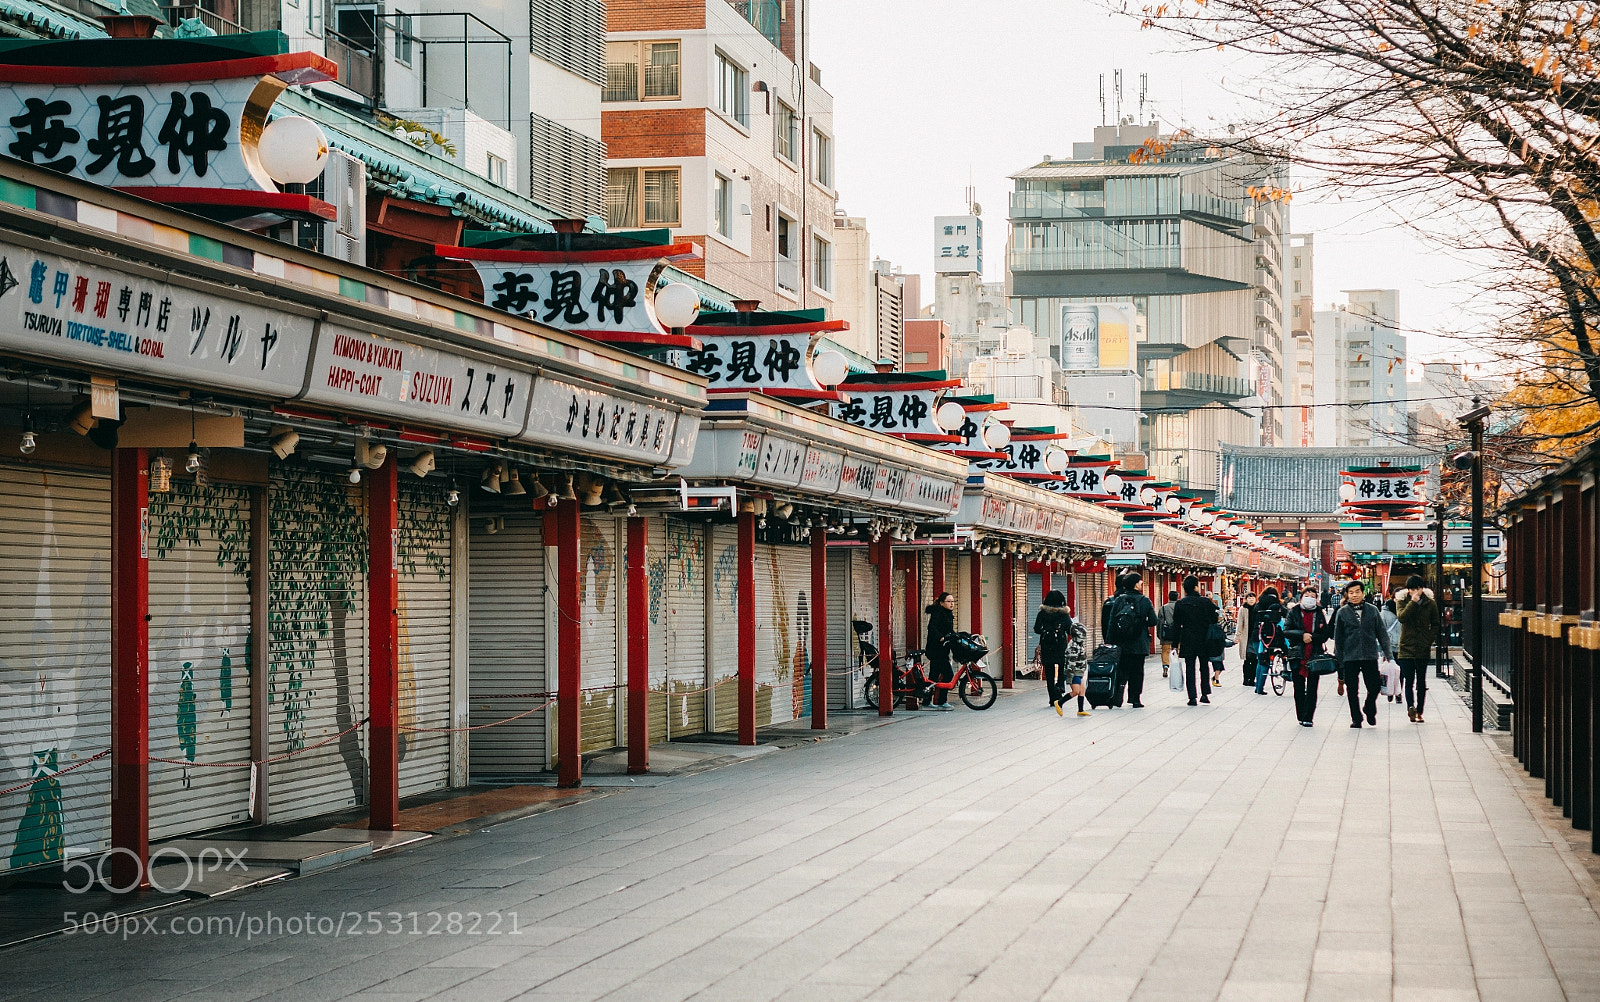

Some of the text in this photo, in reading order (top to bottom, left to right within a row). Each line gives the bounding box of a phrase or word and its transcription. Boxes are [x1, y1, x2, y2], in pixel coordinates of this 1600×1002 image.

[943, 225, 967, 236] 雷門
[941, 244, 969, 258] 三定
[24, 311, 62, 337] TSURUYA
[66, 321, 133, 352] TORTOISE-SHELL
[141, 338, 165, 358] CORAL
[190, 306, 278, 370] ツルヤ
[1064, 327, 1096, 341] Asahi
[333, 334, 367, 362] KIMONO
[373, 345, 403, 371] YUKATA
[328, 365, 382, 397] HAPPI-COAT
[411, 371, 453, 406] SUZUYA
